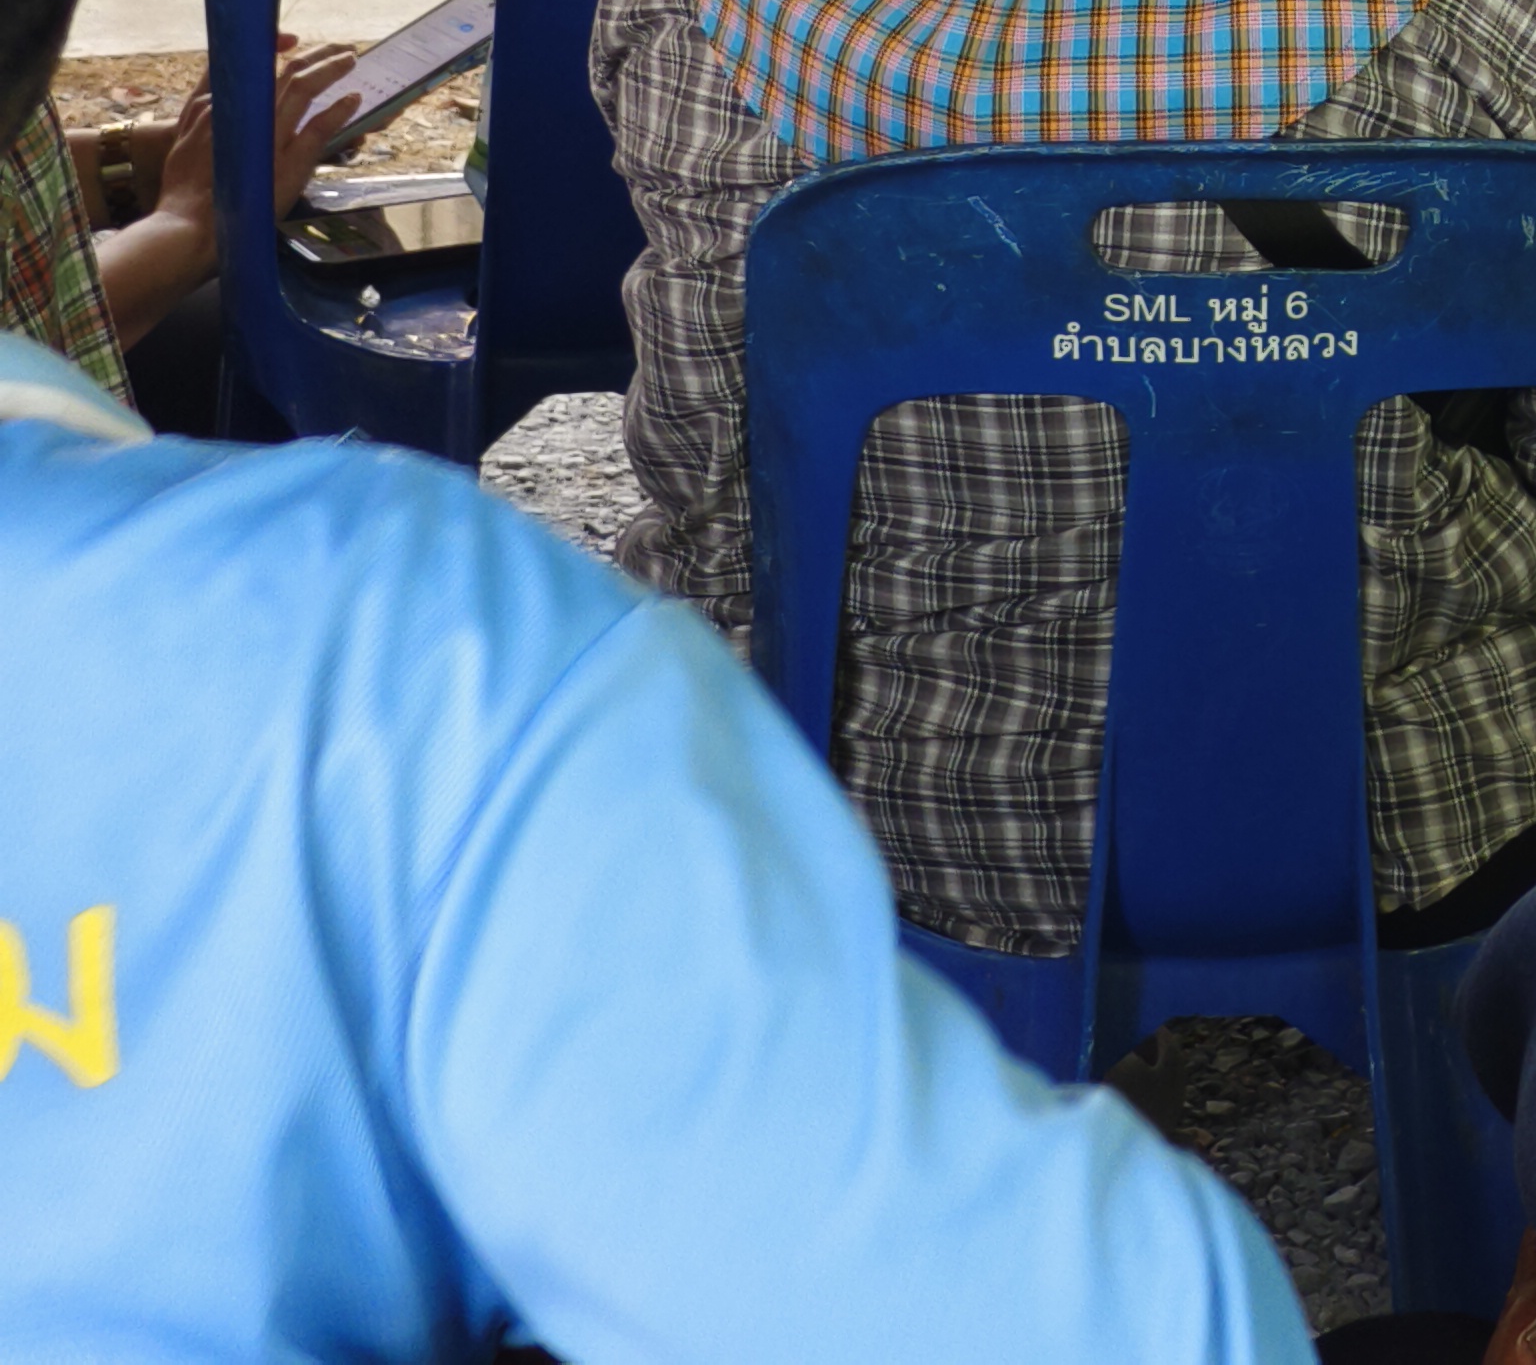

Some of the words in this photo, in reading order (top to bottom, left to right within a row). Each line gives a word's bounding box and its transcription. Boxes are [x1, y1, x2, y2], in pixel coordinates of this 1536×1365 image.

[1103, 293, 1191, 323] SML
[1208, 284, 1269, 334] หมู่
[1285, 291, 1309, 320] 6
[1052, 322, 1359, 364] ตำบลบางหลวง
